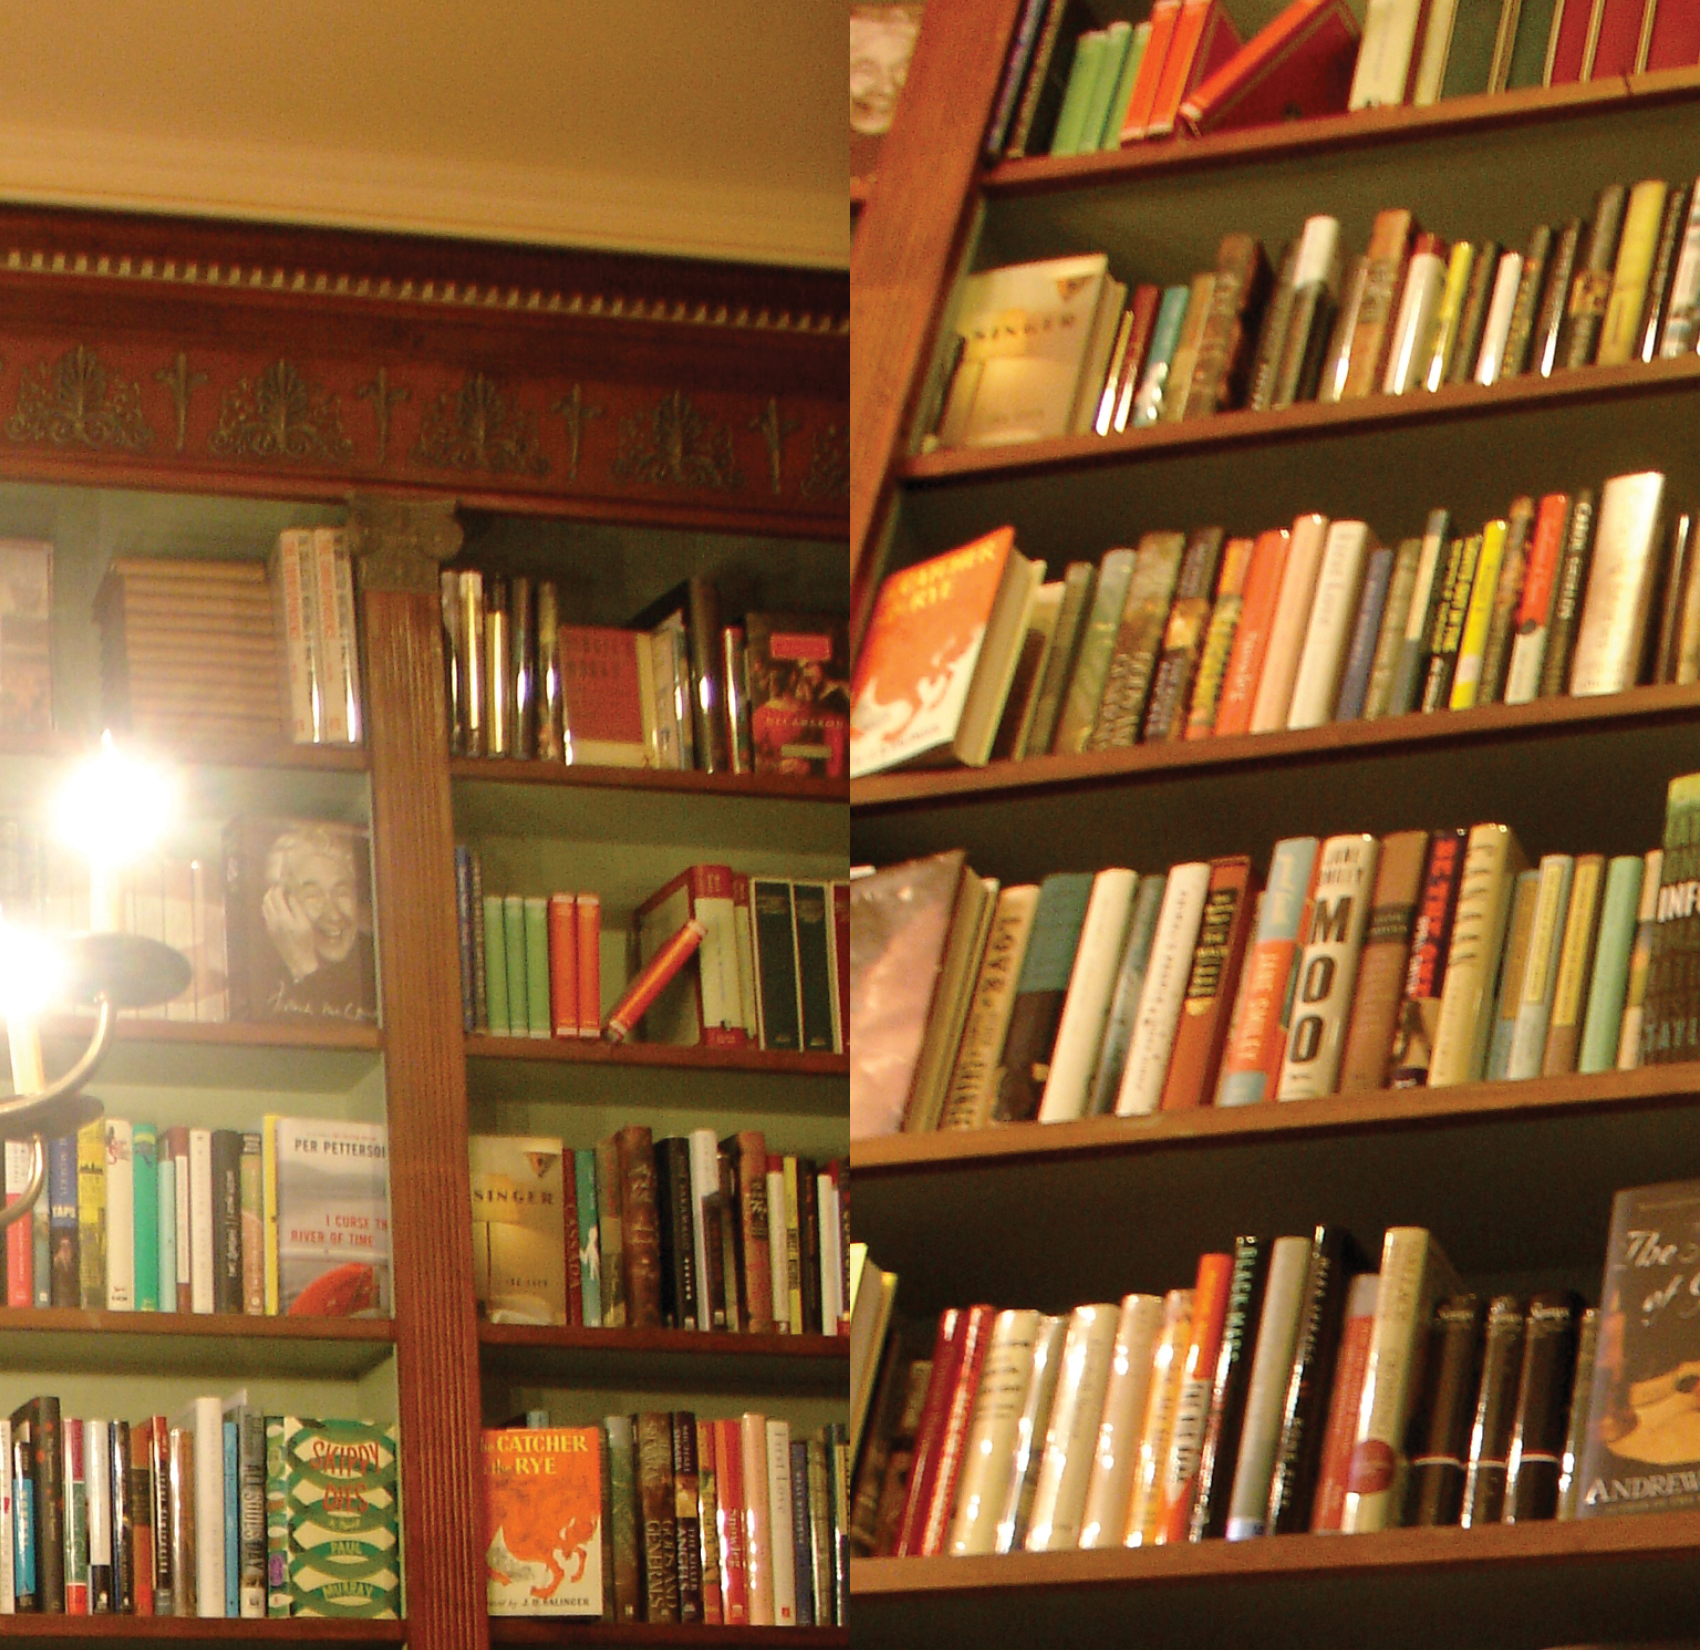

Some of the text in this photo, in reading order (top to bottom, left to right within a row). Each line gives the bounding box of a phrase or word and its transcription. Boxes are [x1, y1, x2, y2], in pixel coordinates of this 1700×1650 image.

[290, 1229, 323, 1242] RIVER
[344, 1234, 376, 1248] TIME
[311, 1439, 381, 1474] SKIPPY
[497, 1435, 588, 1453] CATCHER
[321, 1484, 370, 1512] DIES
[677, 1527, 689, 1593] ANGELS
